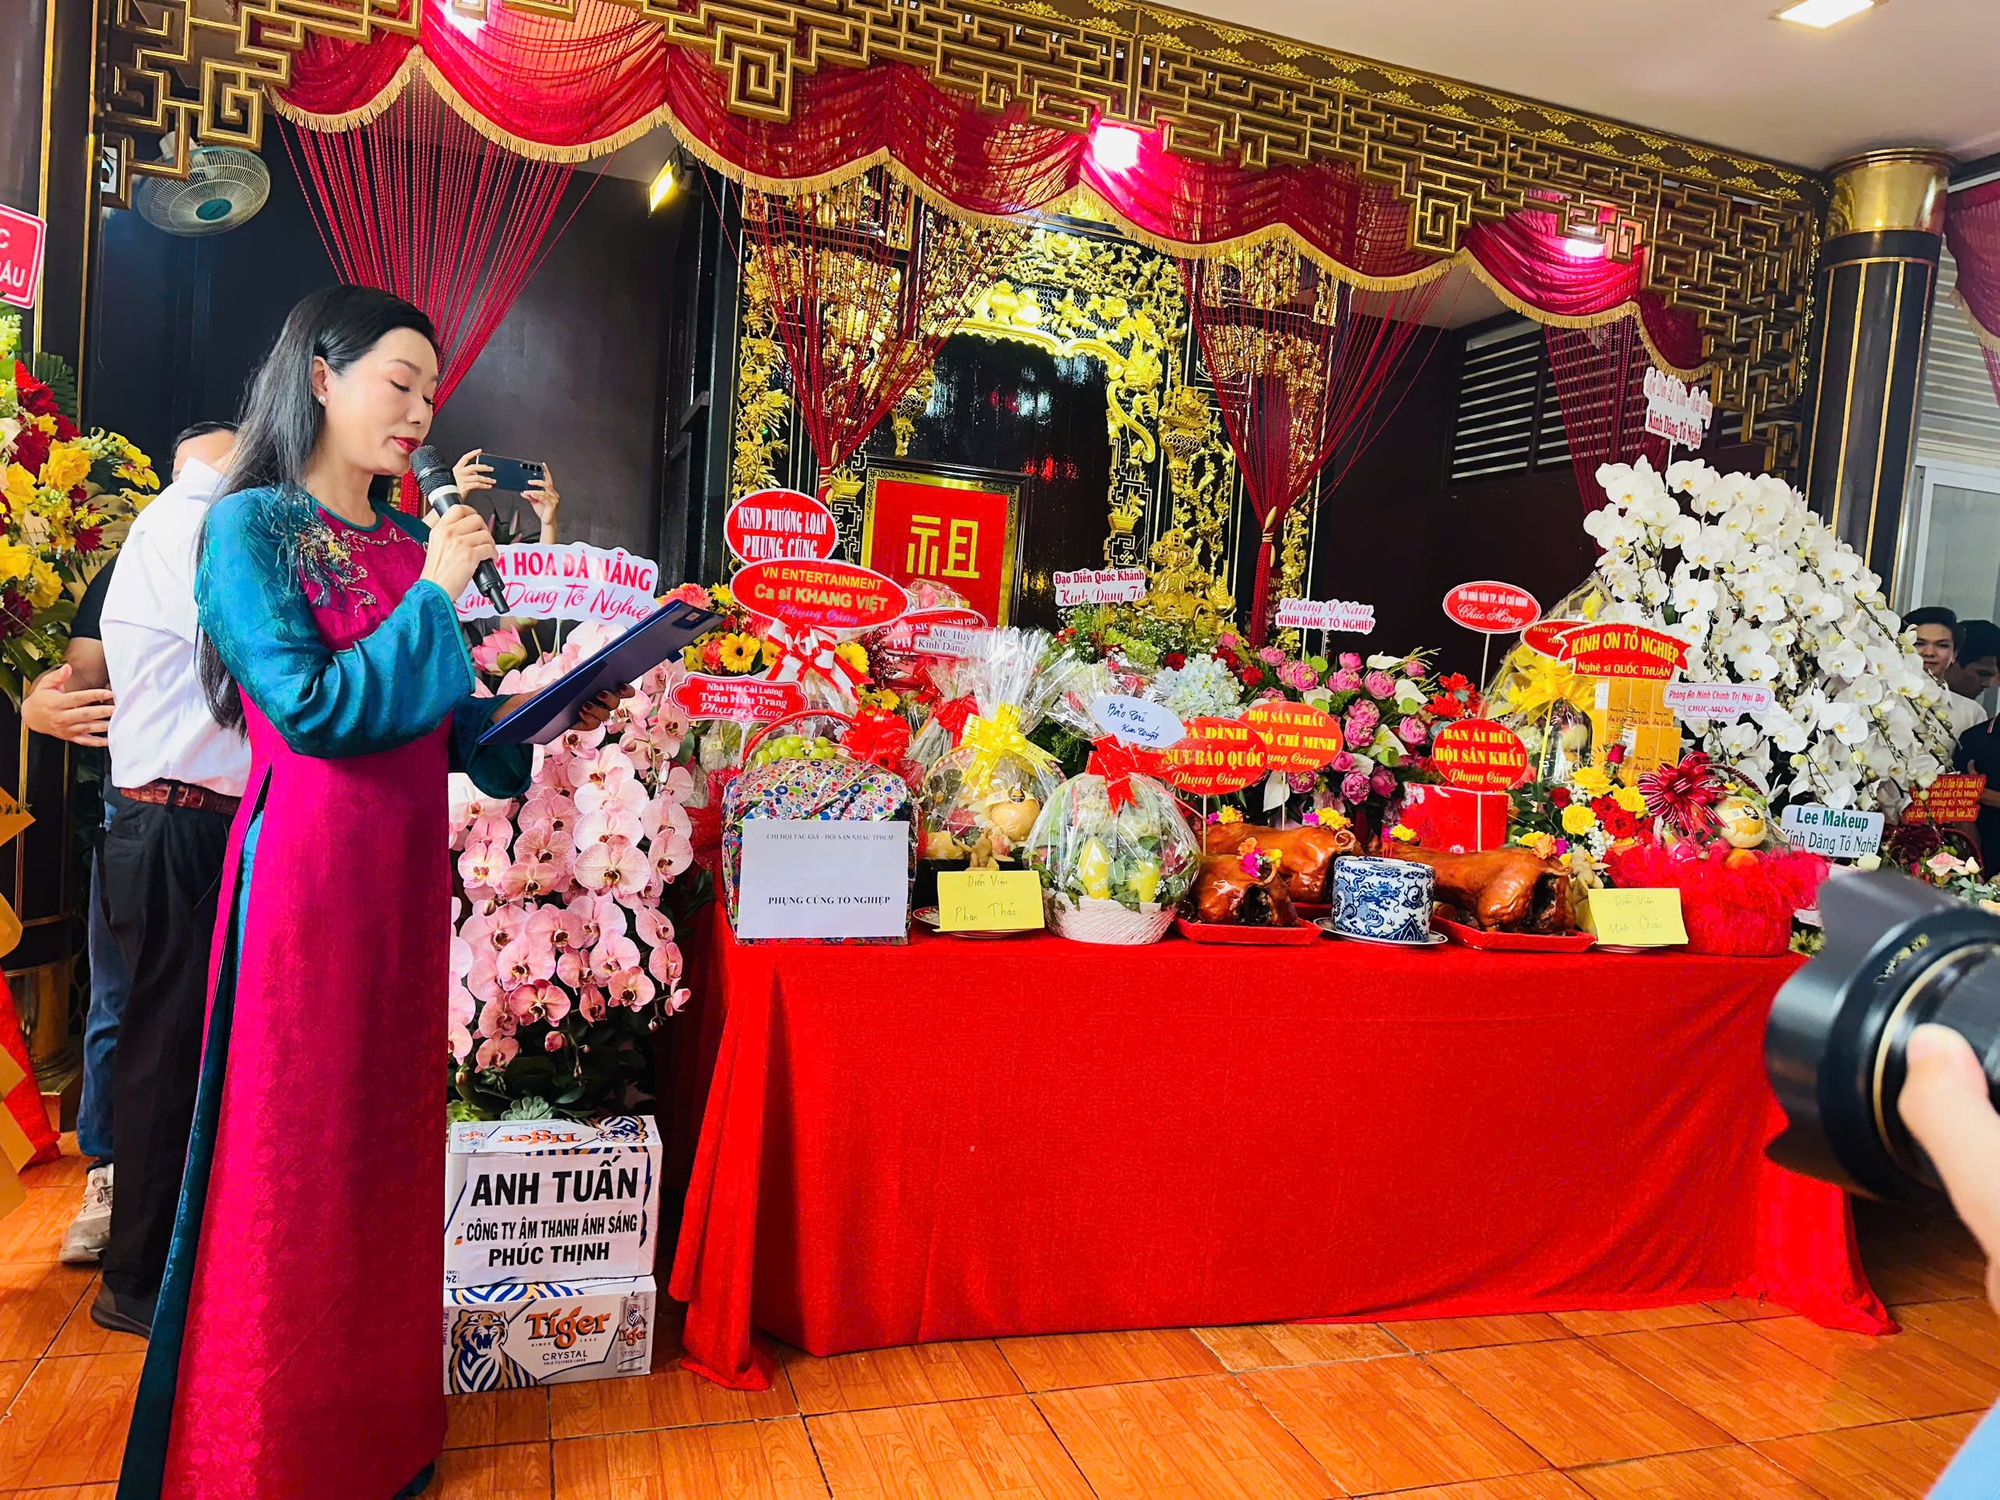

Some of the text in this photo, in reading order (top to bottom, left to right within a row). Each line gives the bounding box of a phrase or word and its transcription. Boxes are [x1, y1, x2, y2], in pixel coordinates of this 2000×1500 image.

[0, 259, 25, 288] ẤU
[738, 507, 827, 536] NSND PHƯỢNG LOAN
[514, 550, 651, 591] HOA ĐÀ NẴNG
[762, 566, 882, 591] VN ENTERTAINMENT
[1055, 569, 1144, 587] Đạo Diễn Quốc Khánh
[505, 582, 558, 613] Dâng
[564, 584, 589, 609] Tổ
[755, 584, 888, 612] Ca sĩ KHANG VIỆT
[1342, 605, 1371, 616] Nam
[1458, 603, 1485, 619] Chúc
[934, 628, 950, 637] MC
[918, 639, 939, 649] Kính
[1571, 627, 1679, 665] KÍNH ƠN TỔ NGHIỆP
[1577, 662, 1601, 674] Nghệ
[1614, 661, 1639, 674] QUỐC
[1642, 666, 1671, 678] THUẬN
[757, 696, 787, 709] Trang
[1107, 702, 1126, 718] Bảo
[1249, 710, 1327, 728] HỘI SÂN KHẤU
[1205, 724, 1248, 740] ĐÌNH
[1277, 732, 1337, 751] CHÍ MINH
[1443, 728, 1515, 745] BAN ÁI HỮU
[1195, 745, 1265, 769] BẢO QUỐC
[1291, 753, 1320, 767] Cúng
[1435, 745, 1524, 767] HỘI SÂN KHẤU
[1172, 772, 1246, 788] Phụng Cúng
[1448, 769, 1512, 786] Phụng Cúng
[1796, 807, 1869, 832] Lee Makeup
[1808, 832, 1835, 854] Dâng
[1840, 831, 1853, 851] Tổ
[1854, 834, 1878, 856] Nghề
[768, 896, 803, 906] PHỤNG
[955, 902, 1016, 922] Phan Thảo
[498, 1130, 583, 1146] Tiger
[471, 1154, 639, 1207] ANH TUẤN
[466, 1211, 638, 1242] CÔNG TY ÂM THANH ÁNH SÁNG
[488, 1239, 610, 1267] PHÚC THỊNH
[524, 1306, 611, 1349] Tiger
[618, 1327, 647, 1346] Tiger
[542, 1350, 588, 1361] CRYSTAL
